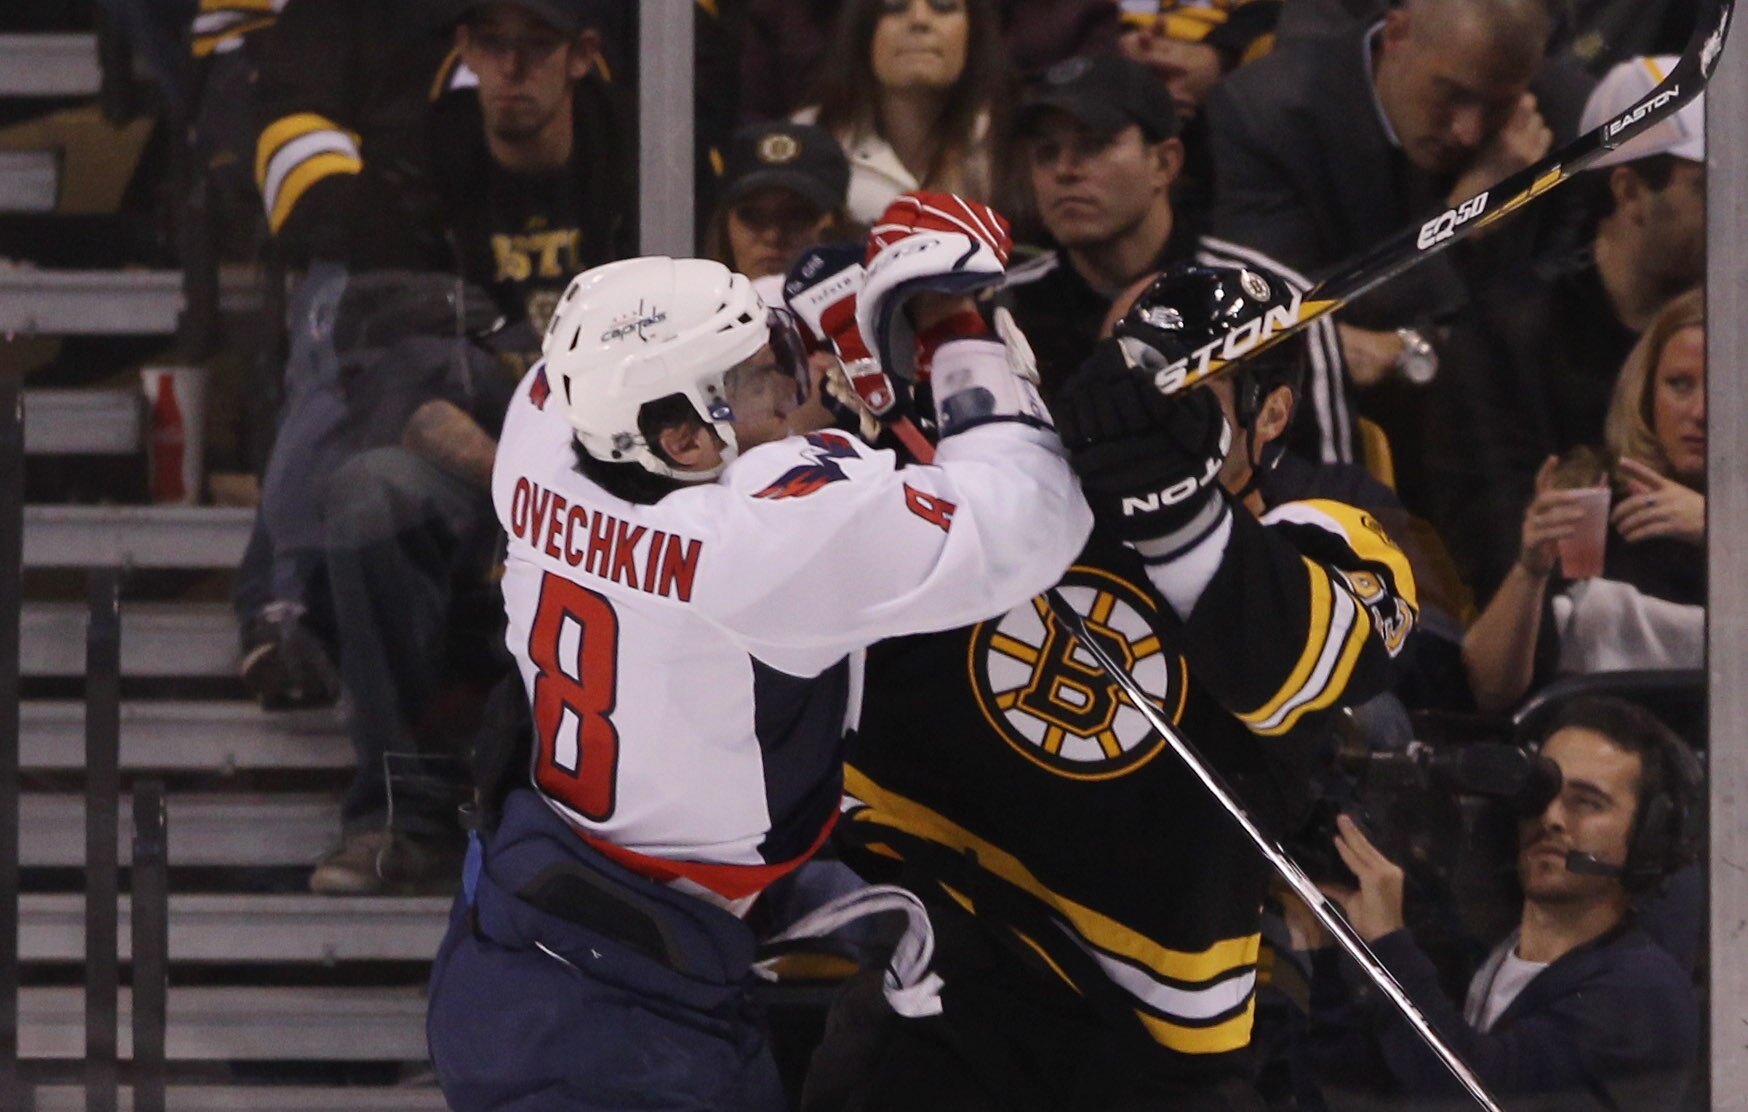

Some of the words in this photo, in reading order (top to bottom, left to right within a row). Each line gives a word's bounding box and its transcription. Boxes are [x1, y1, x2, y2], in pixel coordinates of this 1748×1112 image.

[1610, 84, 1679, 136] EASTON
[1417, 191, 1489, 250] EQ50
[510, 476, 703, 603] OVECHKIN
[528, 569, 620, 823] 8
